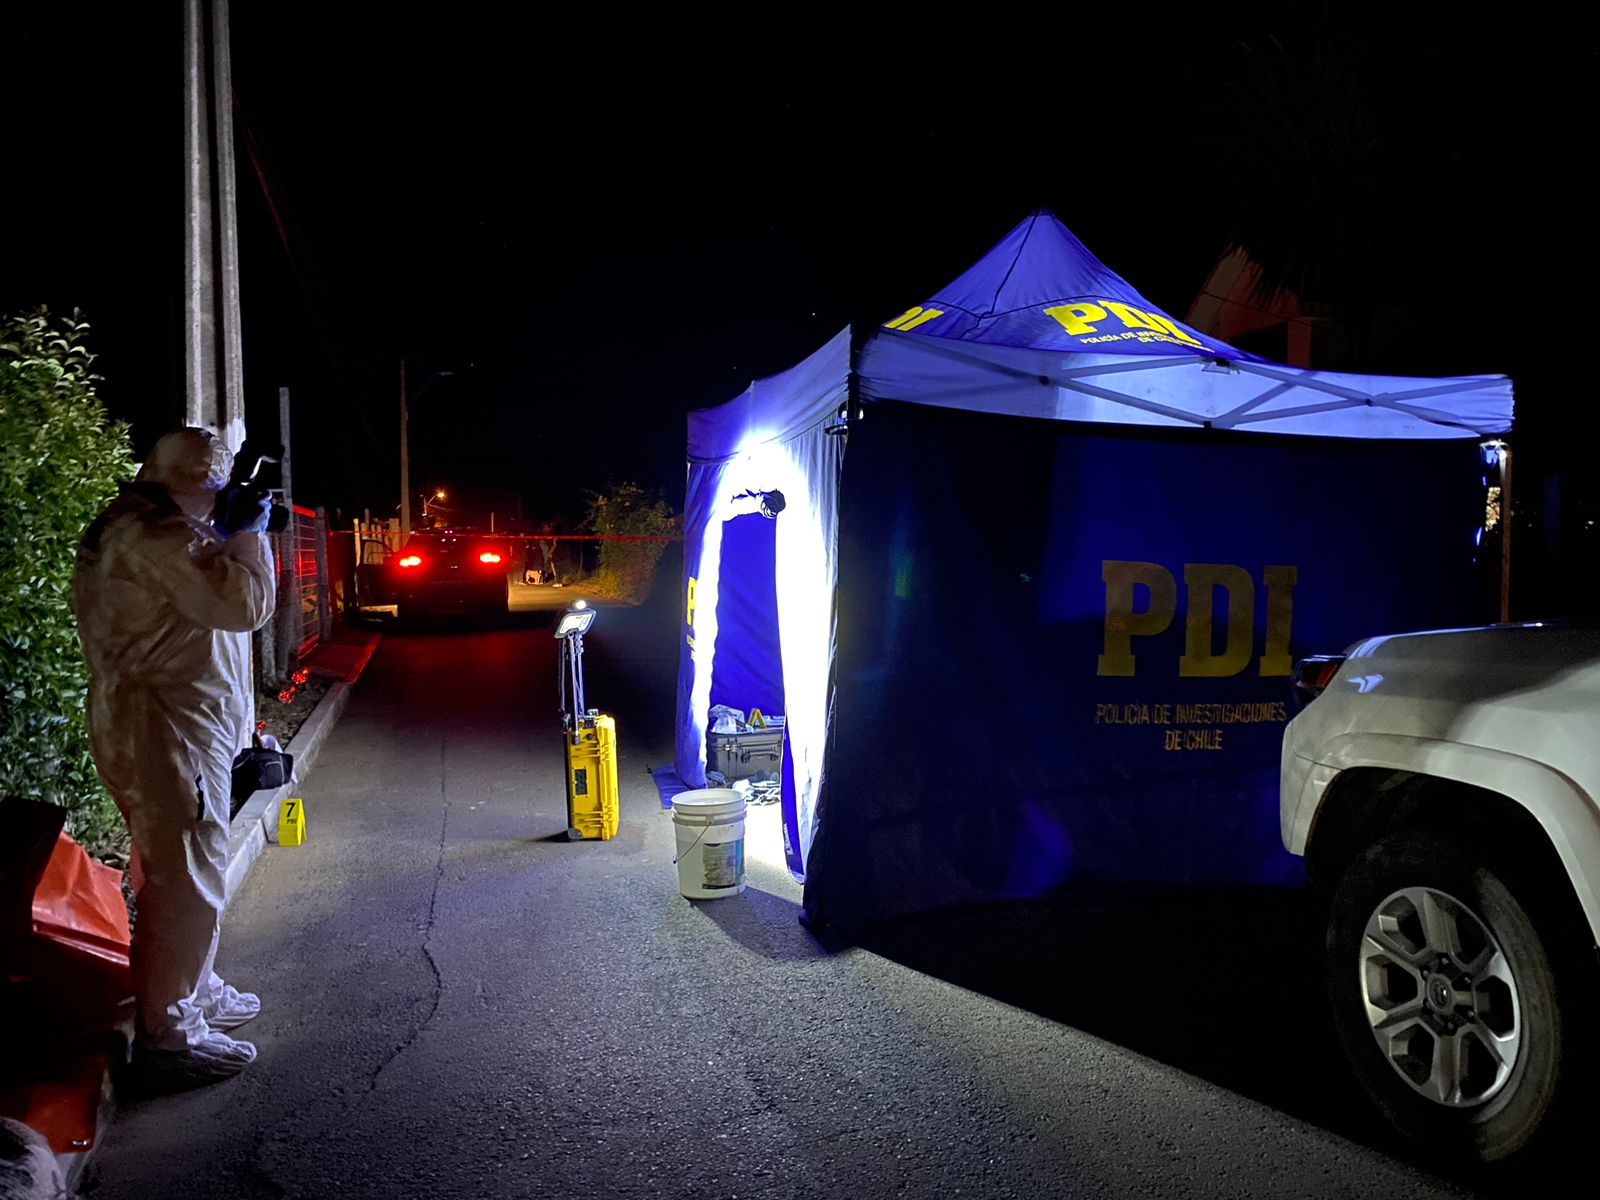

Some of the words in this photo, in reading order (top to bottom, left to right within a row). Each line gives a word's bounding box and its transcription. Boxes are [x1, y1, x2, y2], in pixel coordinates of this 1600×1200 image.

[1096, 560, 1298, 677] PDI
[1152, 703, 1172, 724] DE
[1175, 702, 1287, 724] INVESTIGACIONES
[1164, 730, 1183, 750] DE
[1184, 729, 1223, 750] CHILE
[286, 802, 295, 817] 7
